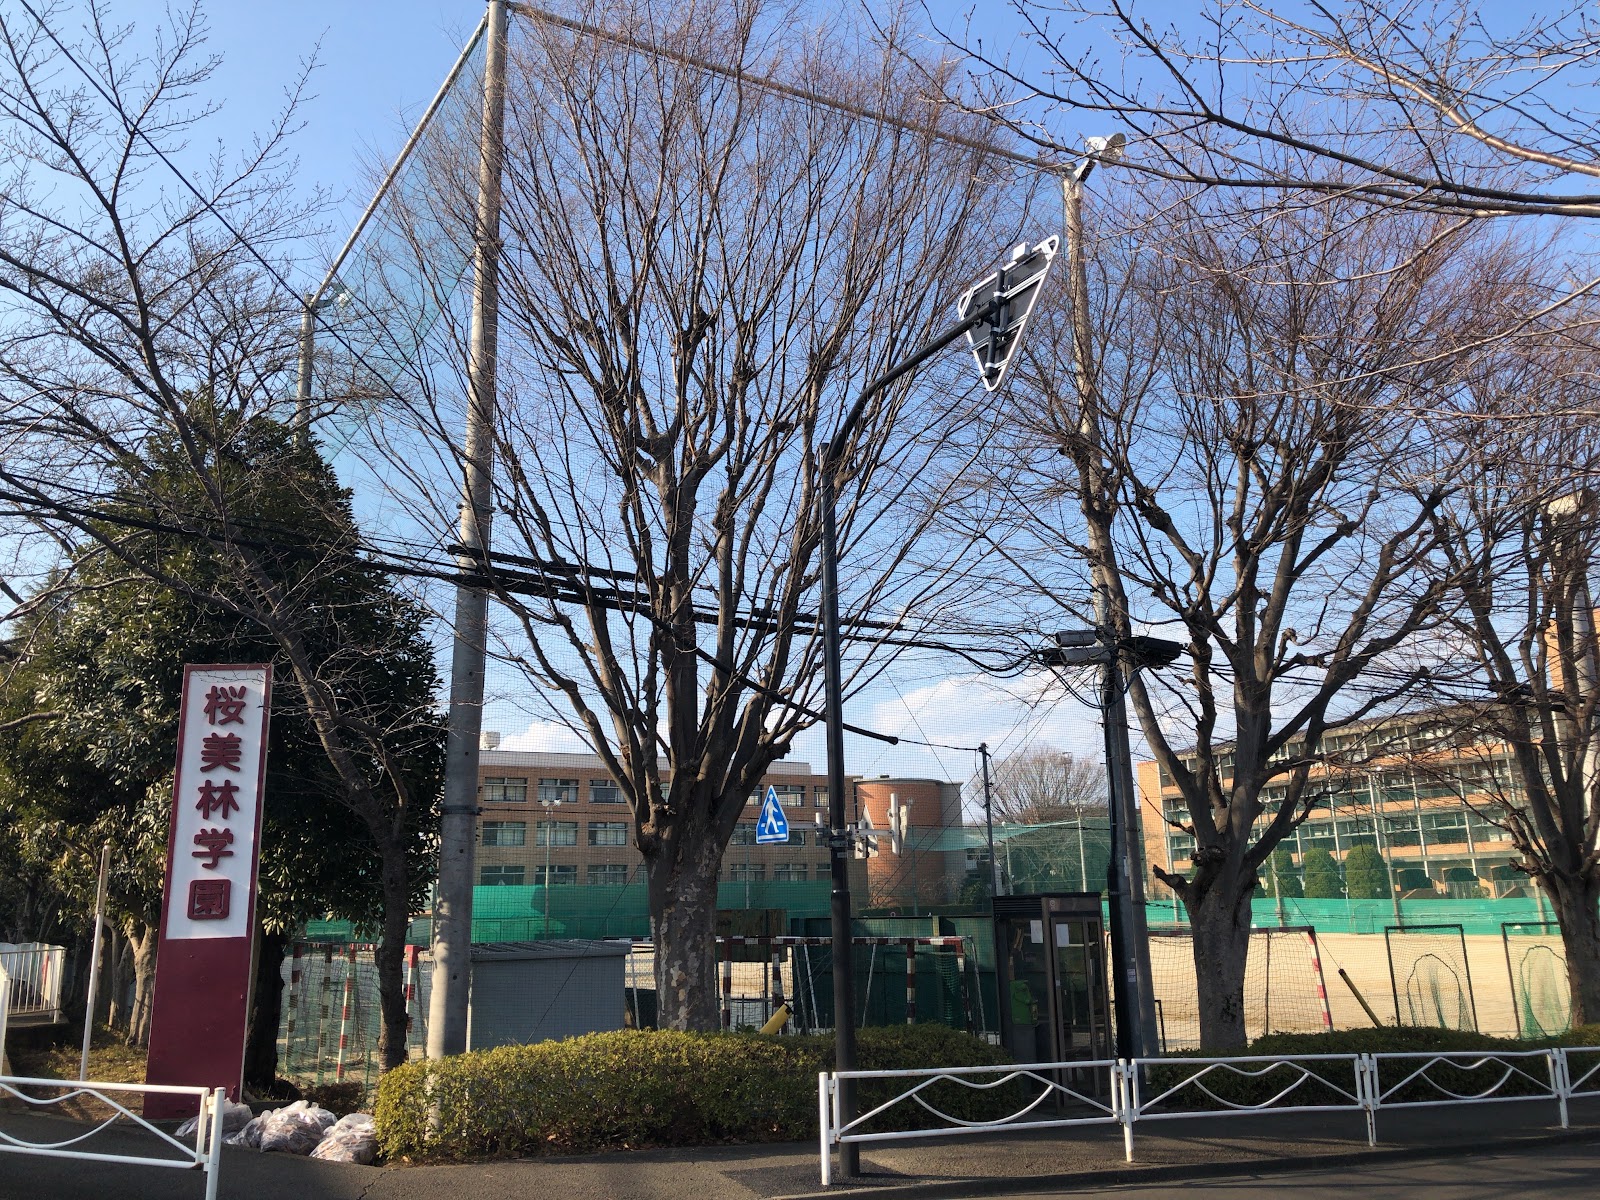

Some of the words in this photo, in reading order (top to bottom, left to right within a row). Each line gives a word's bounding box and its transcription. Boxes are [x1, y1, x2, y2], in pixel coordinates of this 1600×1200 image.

[187, 685, 247, 921] 桜美林学園
